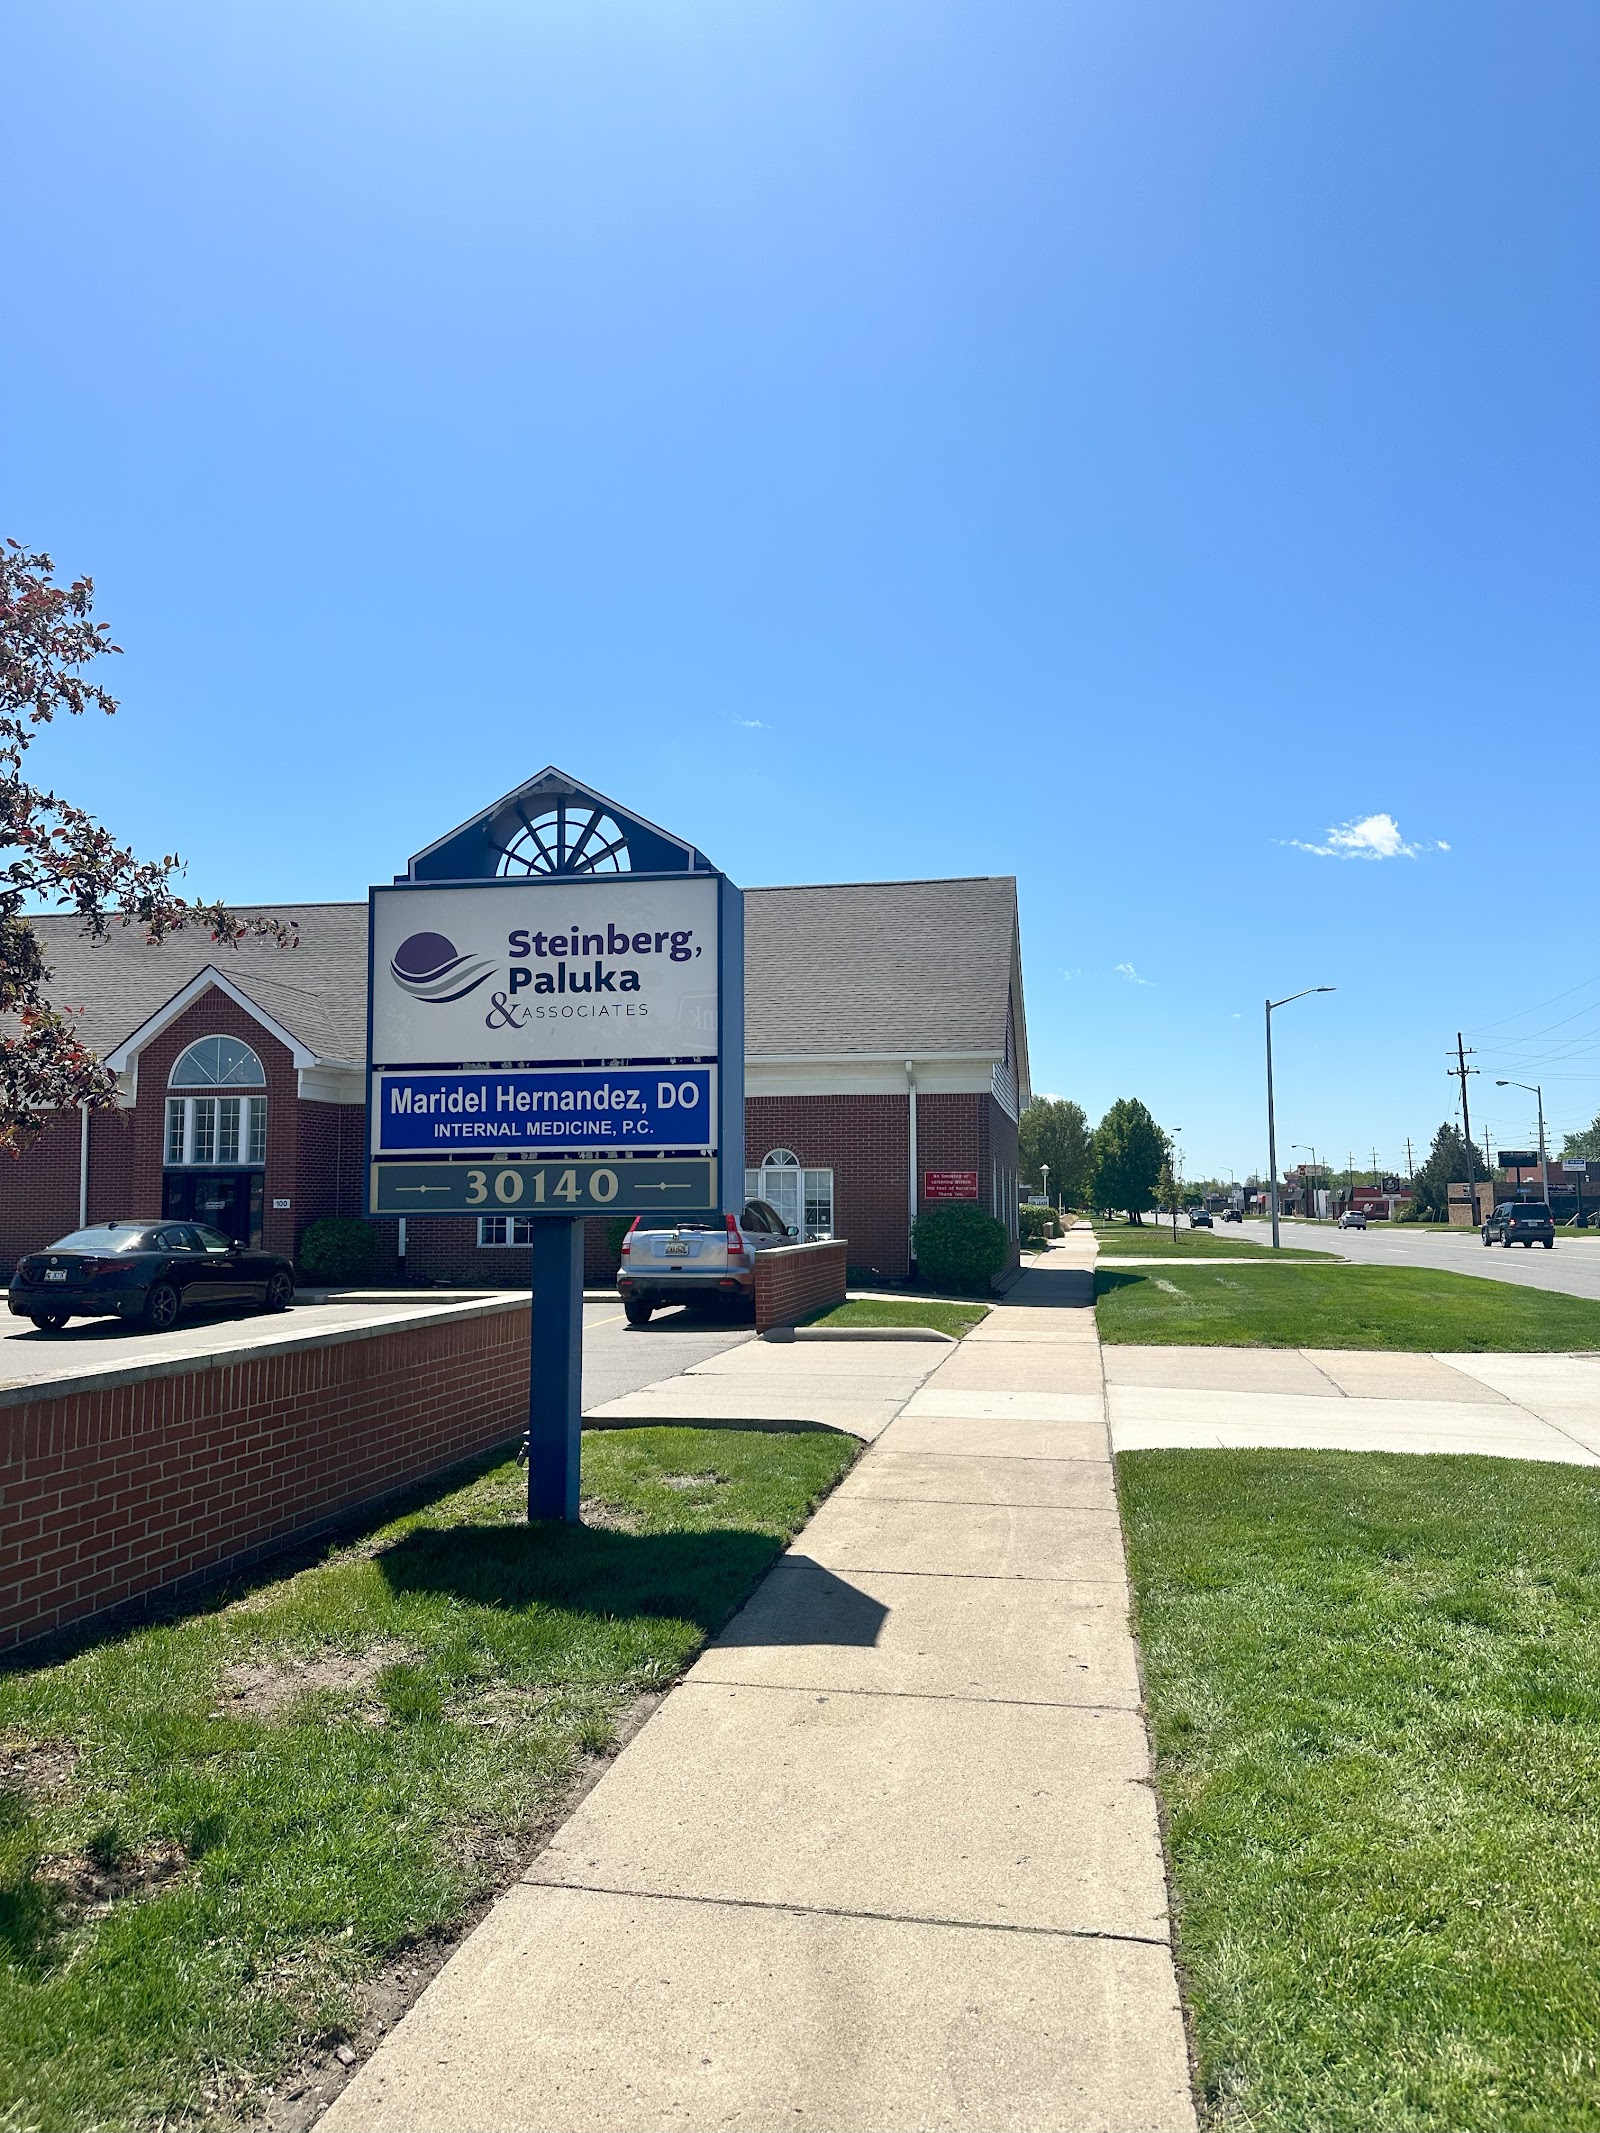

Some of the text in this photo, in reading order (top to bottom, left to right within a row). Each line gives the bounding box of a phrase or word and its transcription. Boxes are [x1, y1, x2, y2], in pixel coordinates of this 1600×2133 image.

[508, 923, 702, 962] Steinberg,
[508, 961, 641, 995] Paluka
[485, 991, 649, 1029] & ASSOCIATES
[390, 1081, 700, 1115] Maridel Hernandez, DO
[434, 1119, 654, 1138] INTERNAL MEDICINE, P.C.
[465, 1168, 619, 1204] 30140
